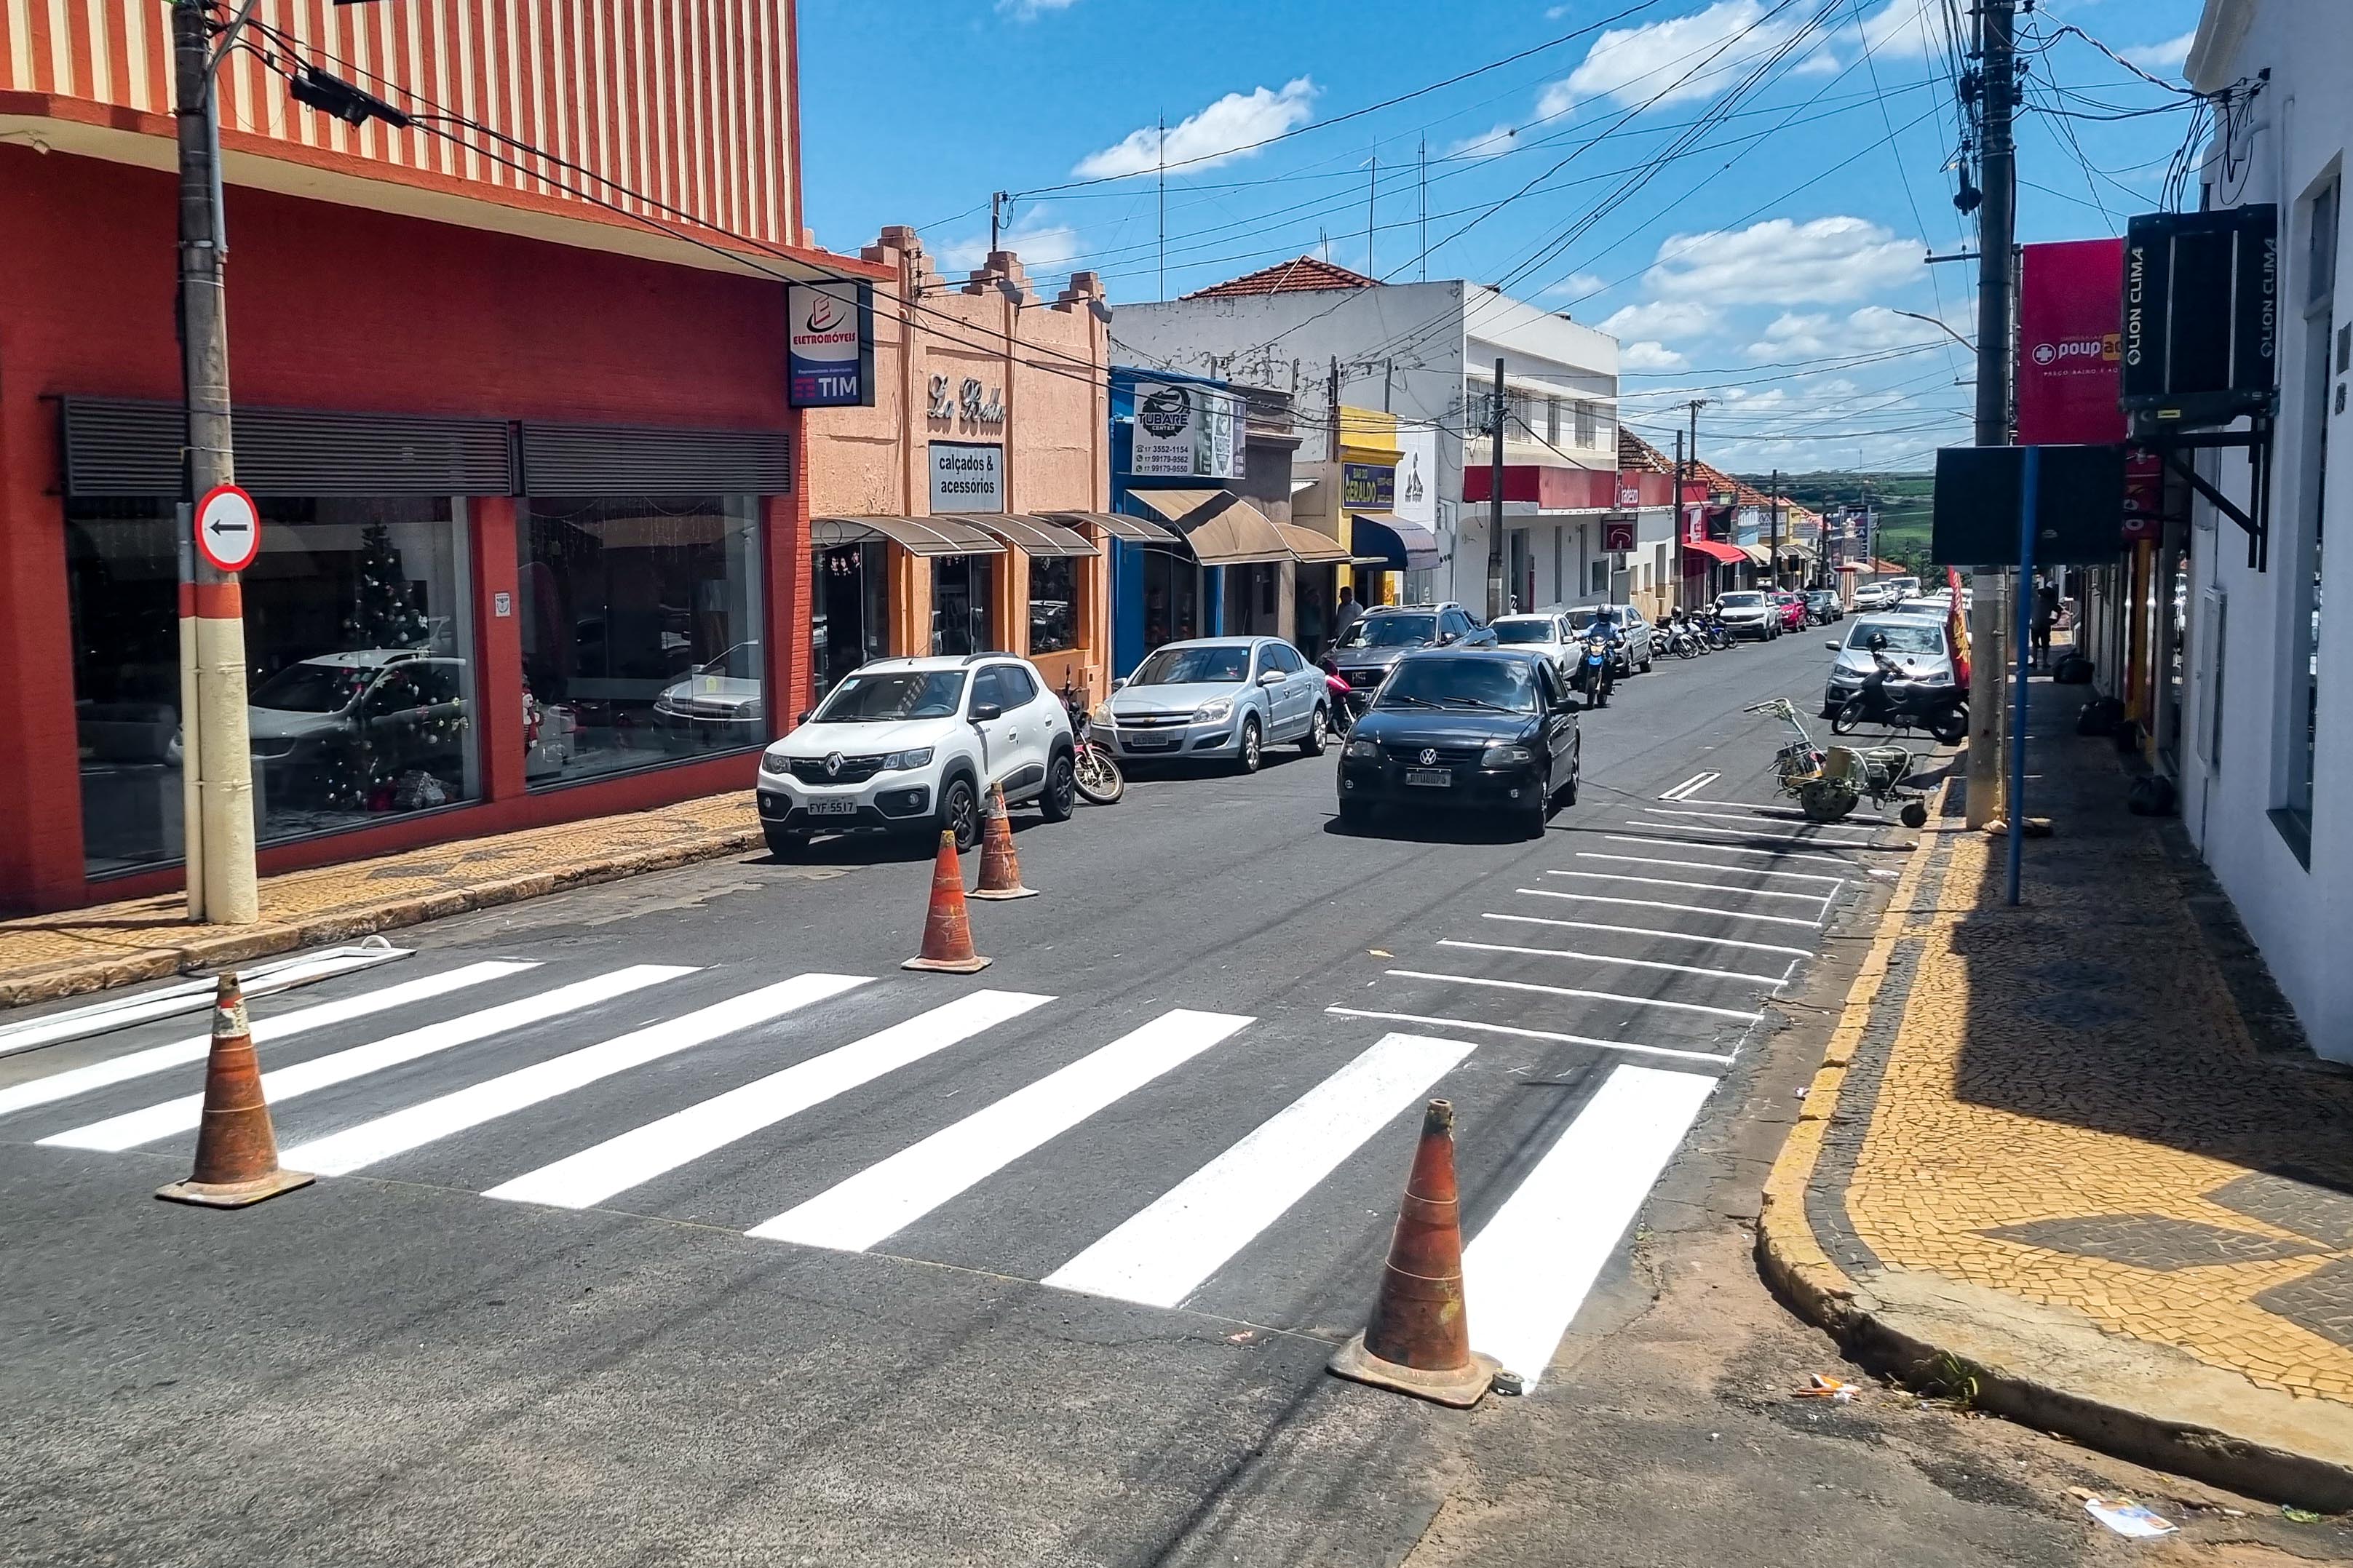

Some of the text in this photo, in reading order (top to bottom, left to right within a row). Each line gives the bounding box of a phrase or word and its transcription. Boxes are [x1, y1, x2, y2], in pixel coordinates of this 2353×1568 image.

[2130, 247, 2143, 303] CLIMA
[2263, 237, 2278, 295] CLIMA
[793, 331, 856, 345] ELETROMÓVEIS
[818, 376, 857, 397] TIM
[939, 454, 994, 474] calçados &
[940, 477, 995, 494] acessórios
[1345, 480, 1376, 502] GERALDO
[810, 803, 854, 813] FYF 5517
